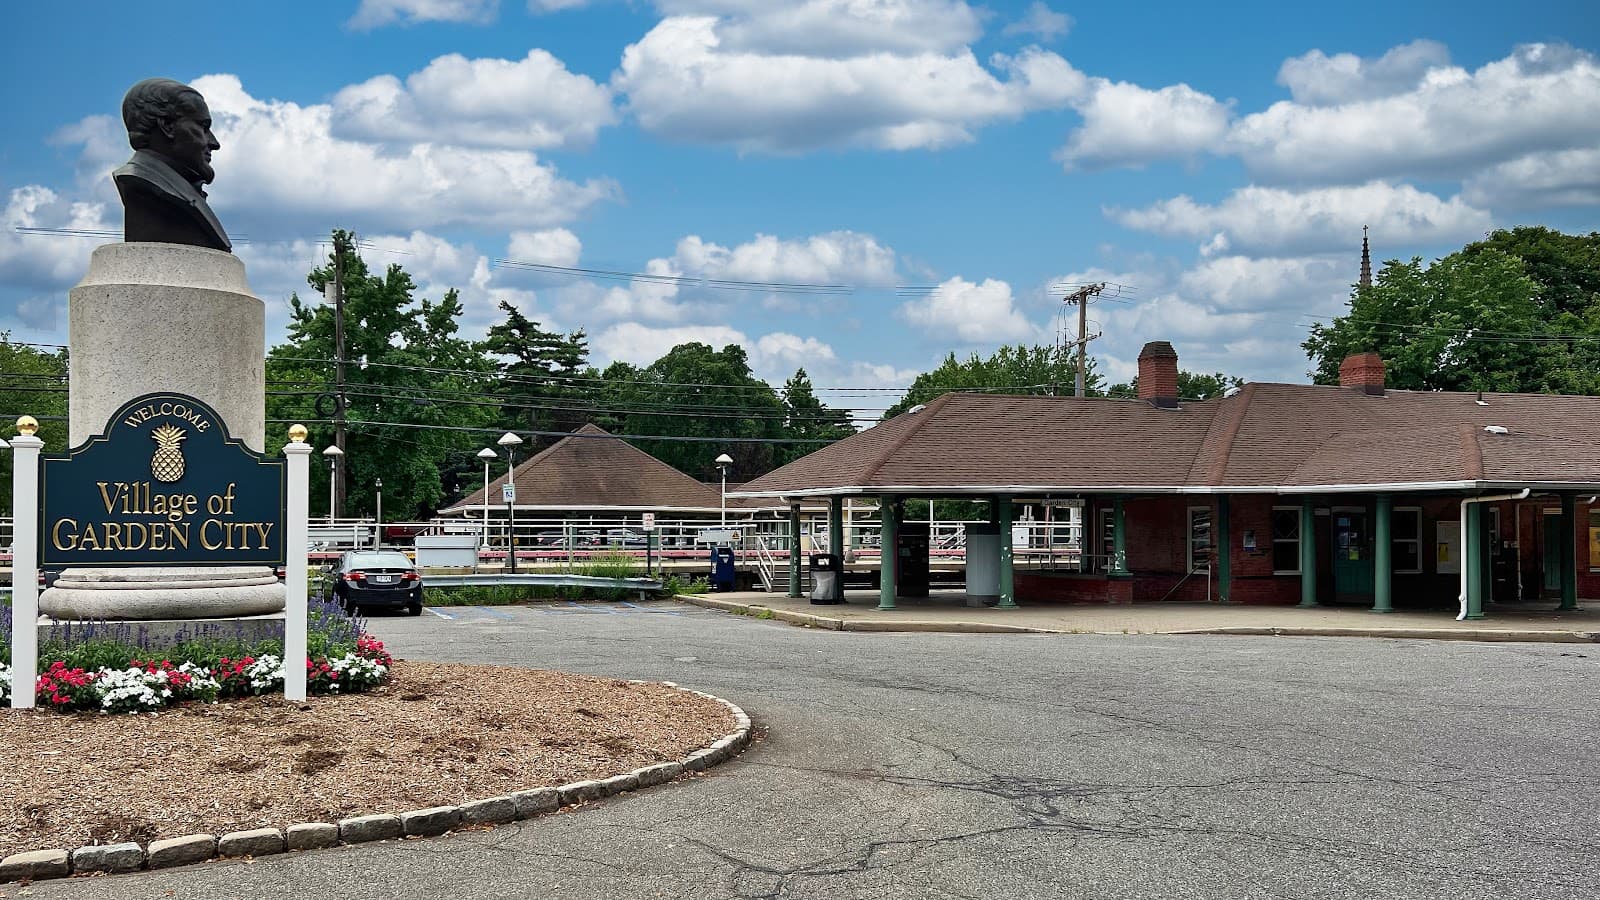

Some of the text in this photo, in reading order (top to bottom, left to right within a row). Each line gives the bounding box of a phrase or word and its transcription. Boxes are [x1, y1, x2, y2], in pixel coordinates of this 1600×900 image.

[124, 402, 210, 432] WELCOME
[96, 481, 236, 521] Village of
[52, 518, 274, 550] GARDEN CITY
